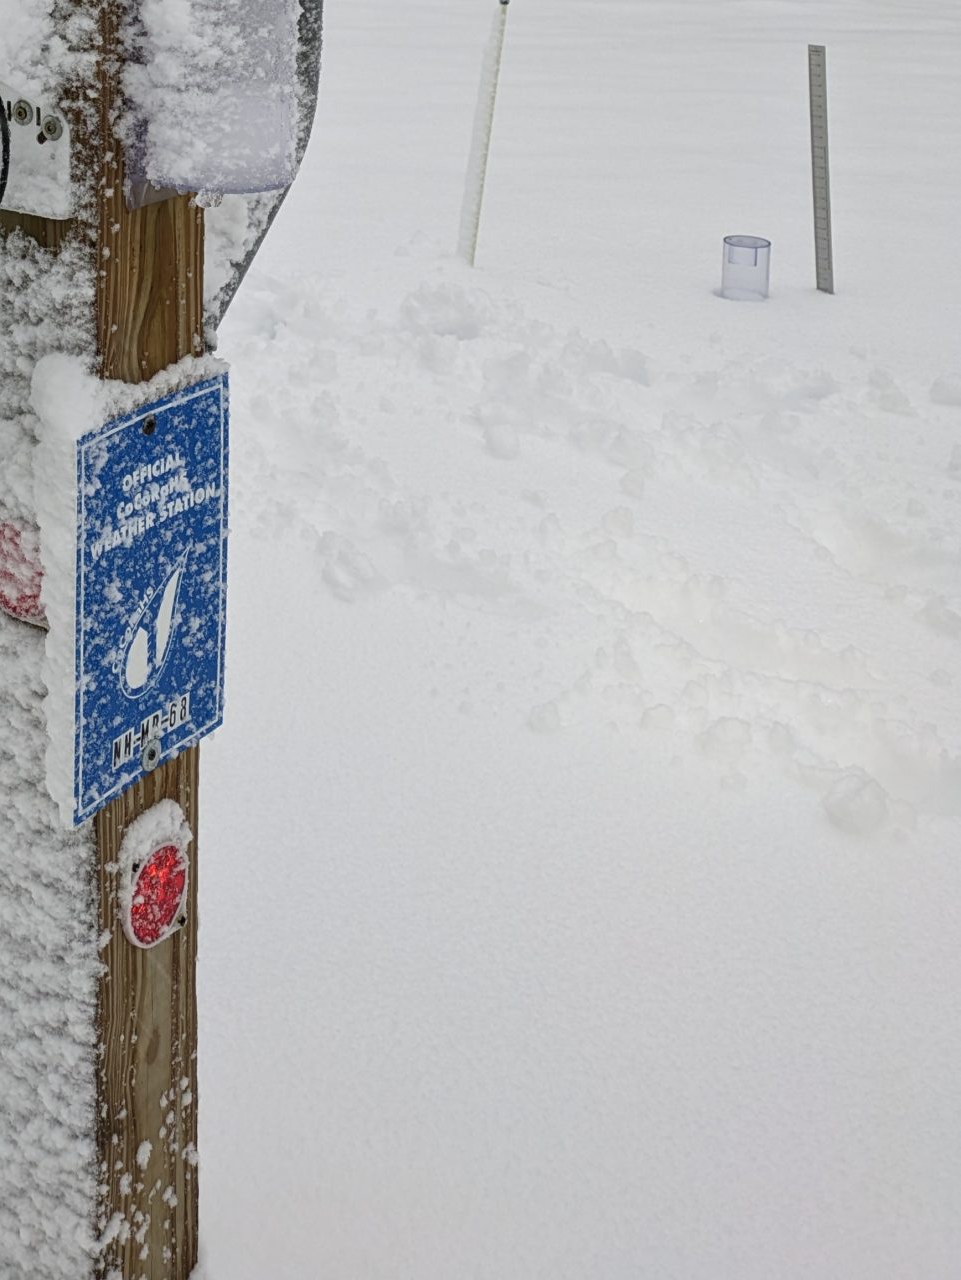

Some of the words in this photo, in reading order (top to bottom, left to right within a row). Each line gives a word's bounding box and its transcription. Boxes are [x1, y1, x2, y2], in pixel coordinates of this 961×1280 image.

[122, 452, 185, 492] OFFICIAL
[91, 512, 157, 560] WEATHER
[159, 482, 216, 522] STATION
